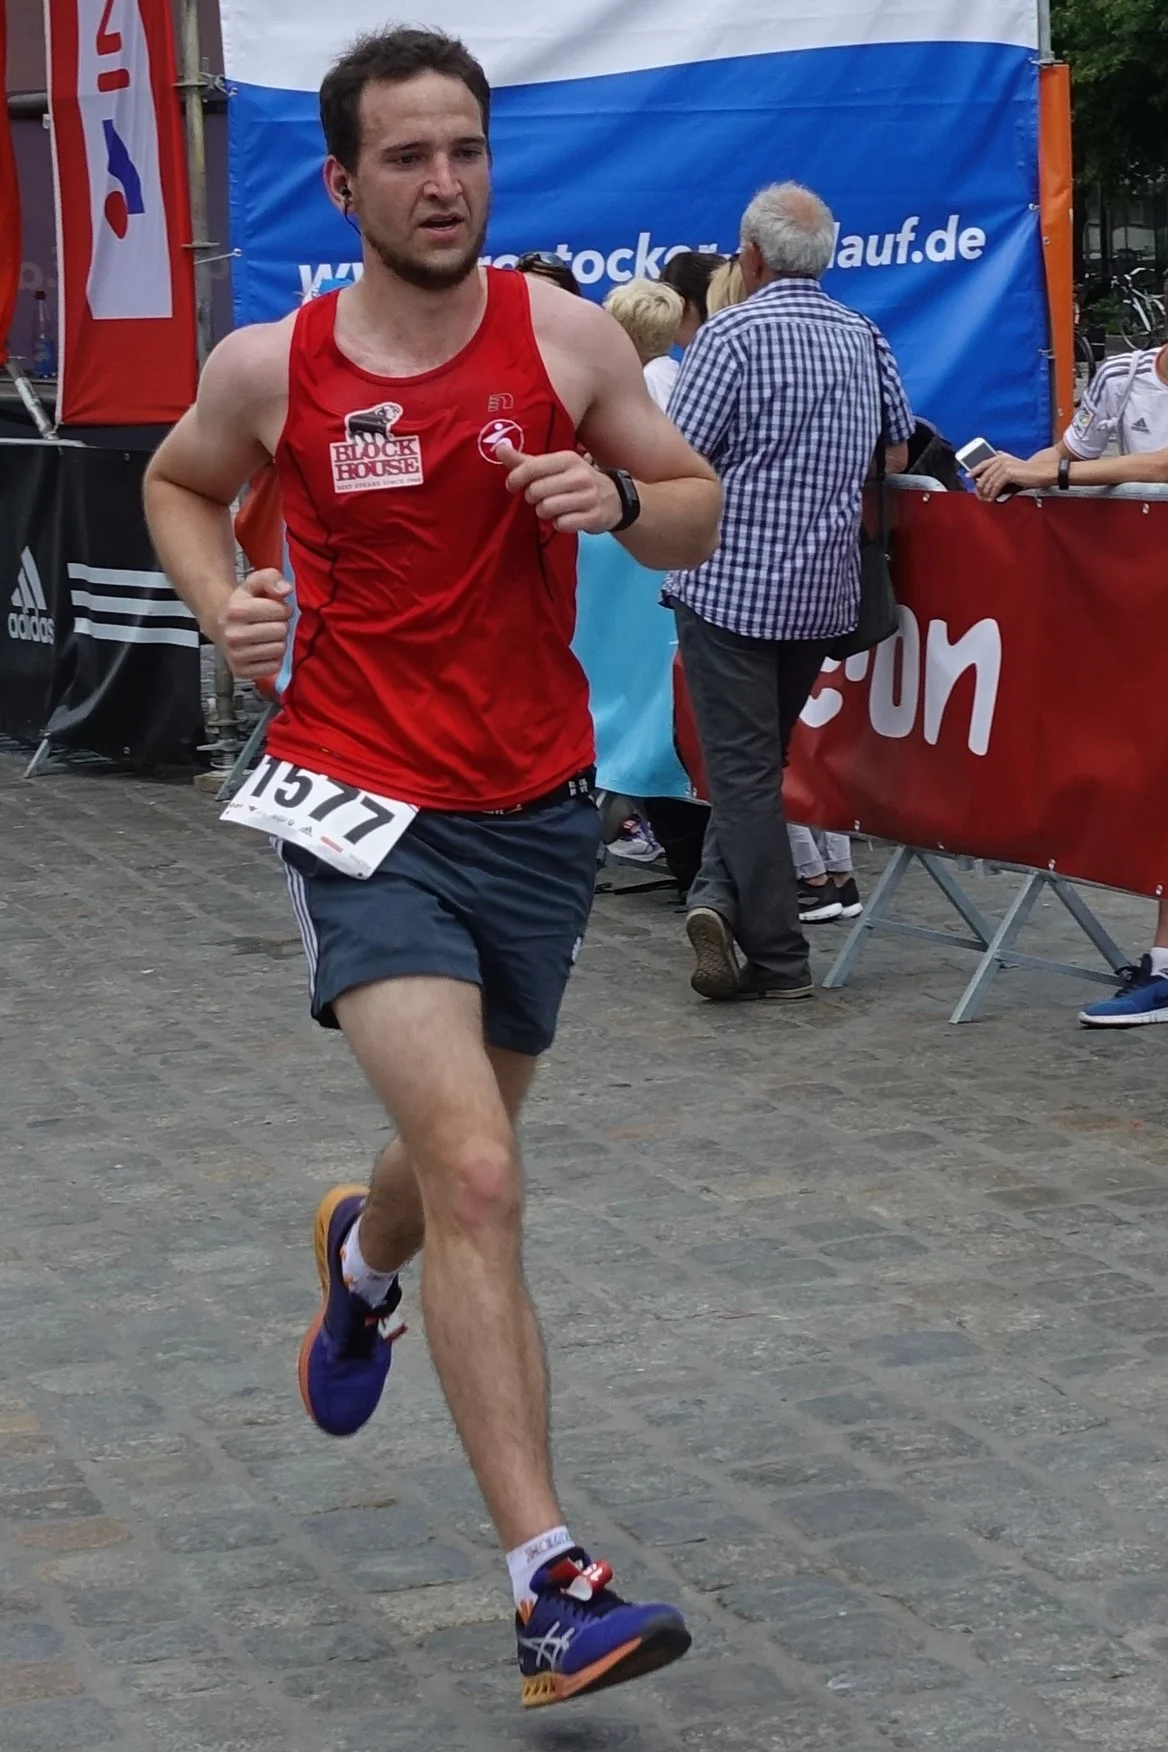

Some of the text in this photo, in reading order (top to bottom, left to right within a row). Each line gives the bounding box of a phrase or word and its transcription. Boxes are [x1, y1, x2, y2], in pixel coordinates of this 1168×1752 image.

[333, 439, 418, 463] BLOCK
[335, 457, 420, 481] HOUSE
[8, 605, 55, 645] adidas
[251, 756, 396, 845] 1577
